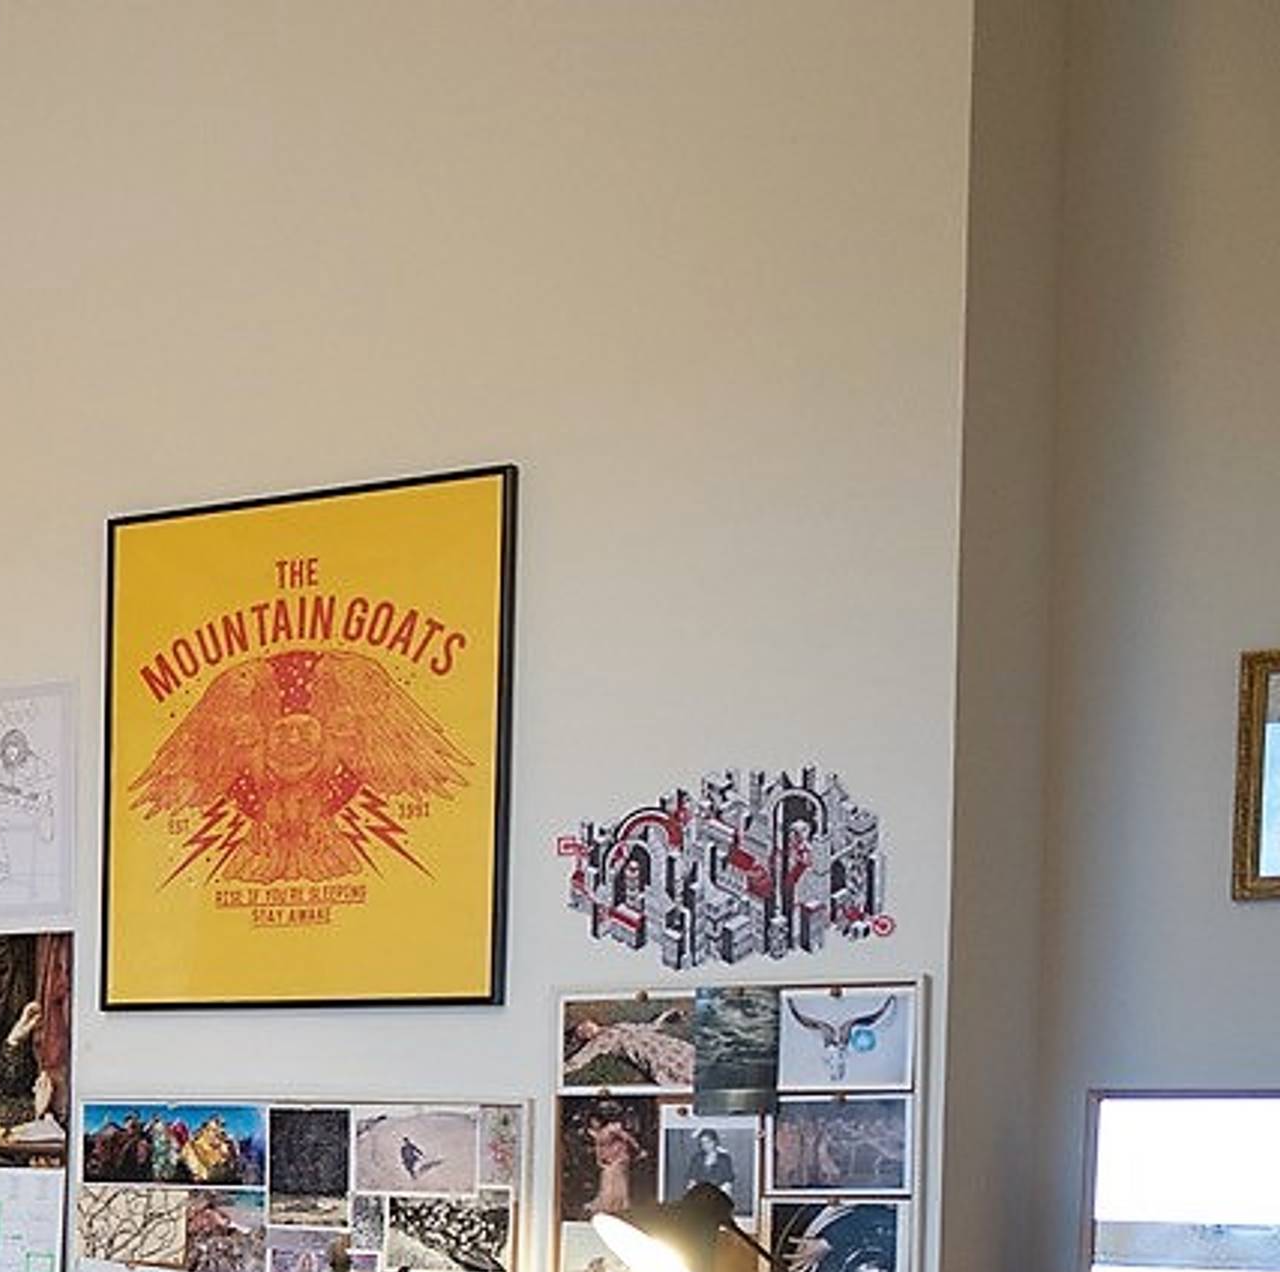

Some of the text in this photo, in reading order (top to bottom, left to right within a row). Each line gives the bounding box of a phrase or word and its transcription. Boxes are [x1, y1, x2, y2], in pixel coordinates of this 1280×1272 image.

[275, 557, 319, 589] THE
[139, 595, 466, 703] MOUNTAIN GOATS
